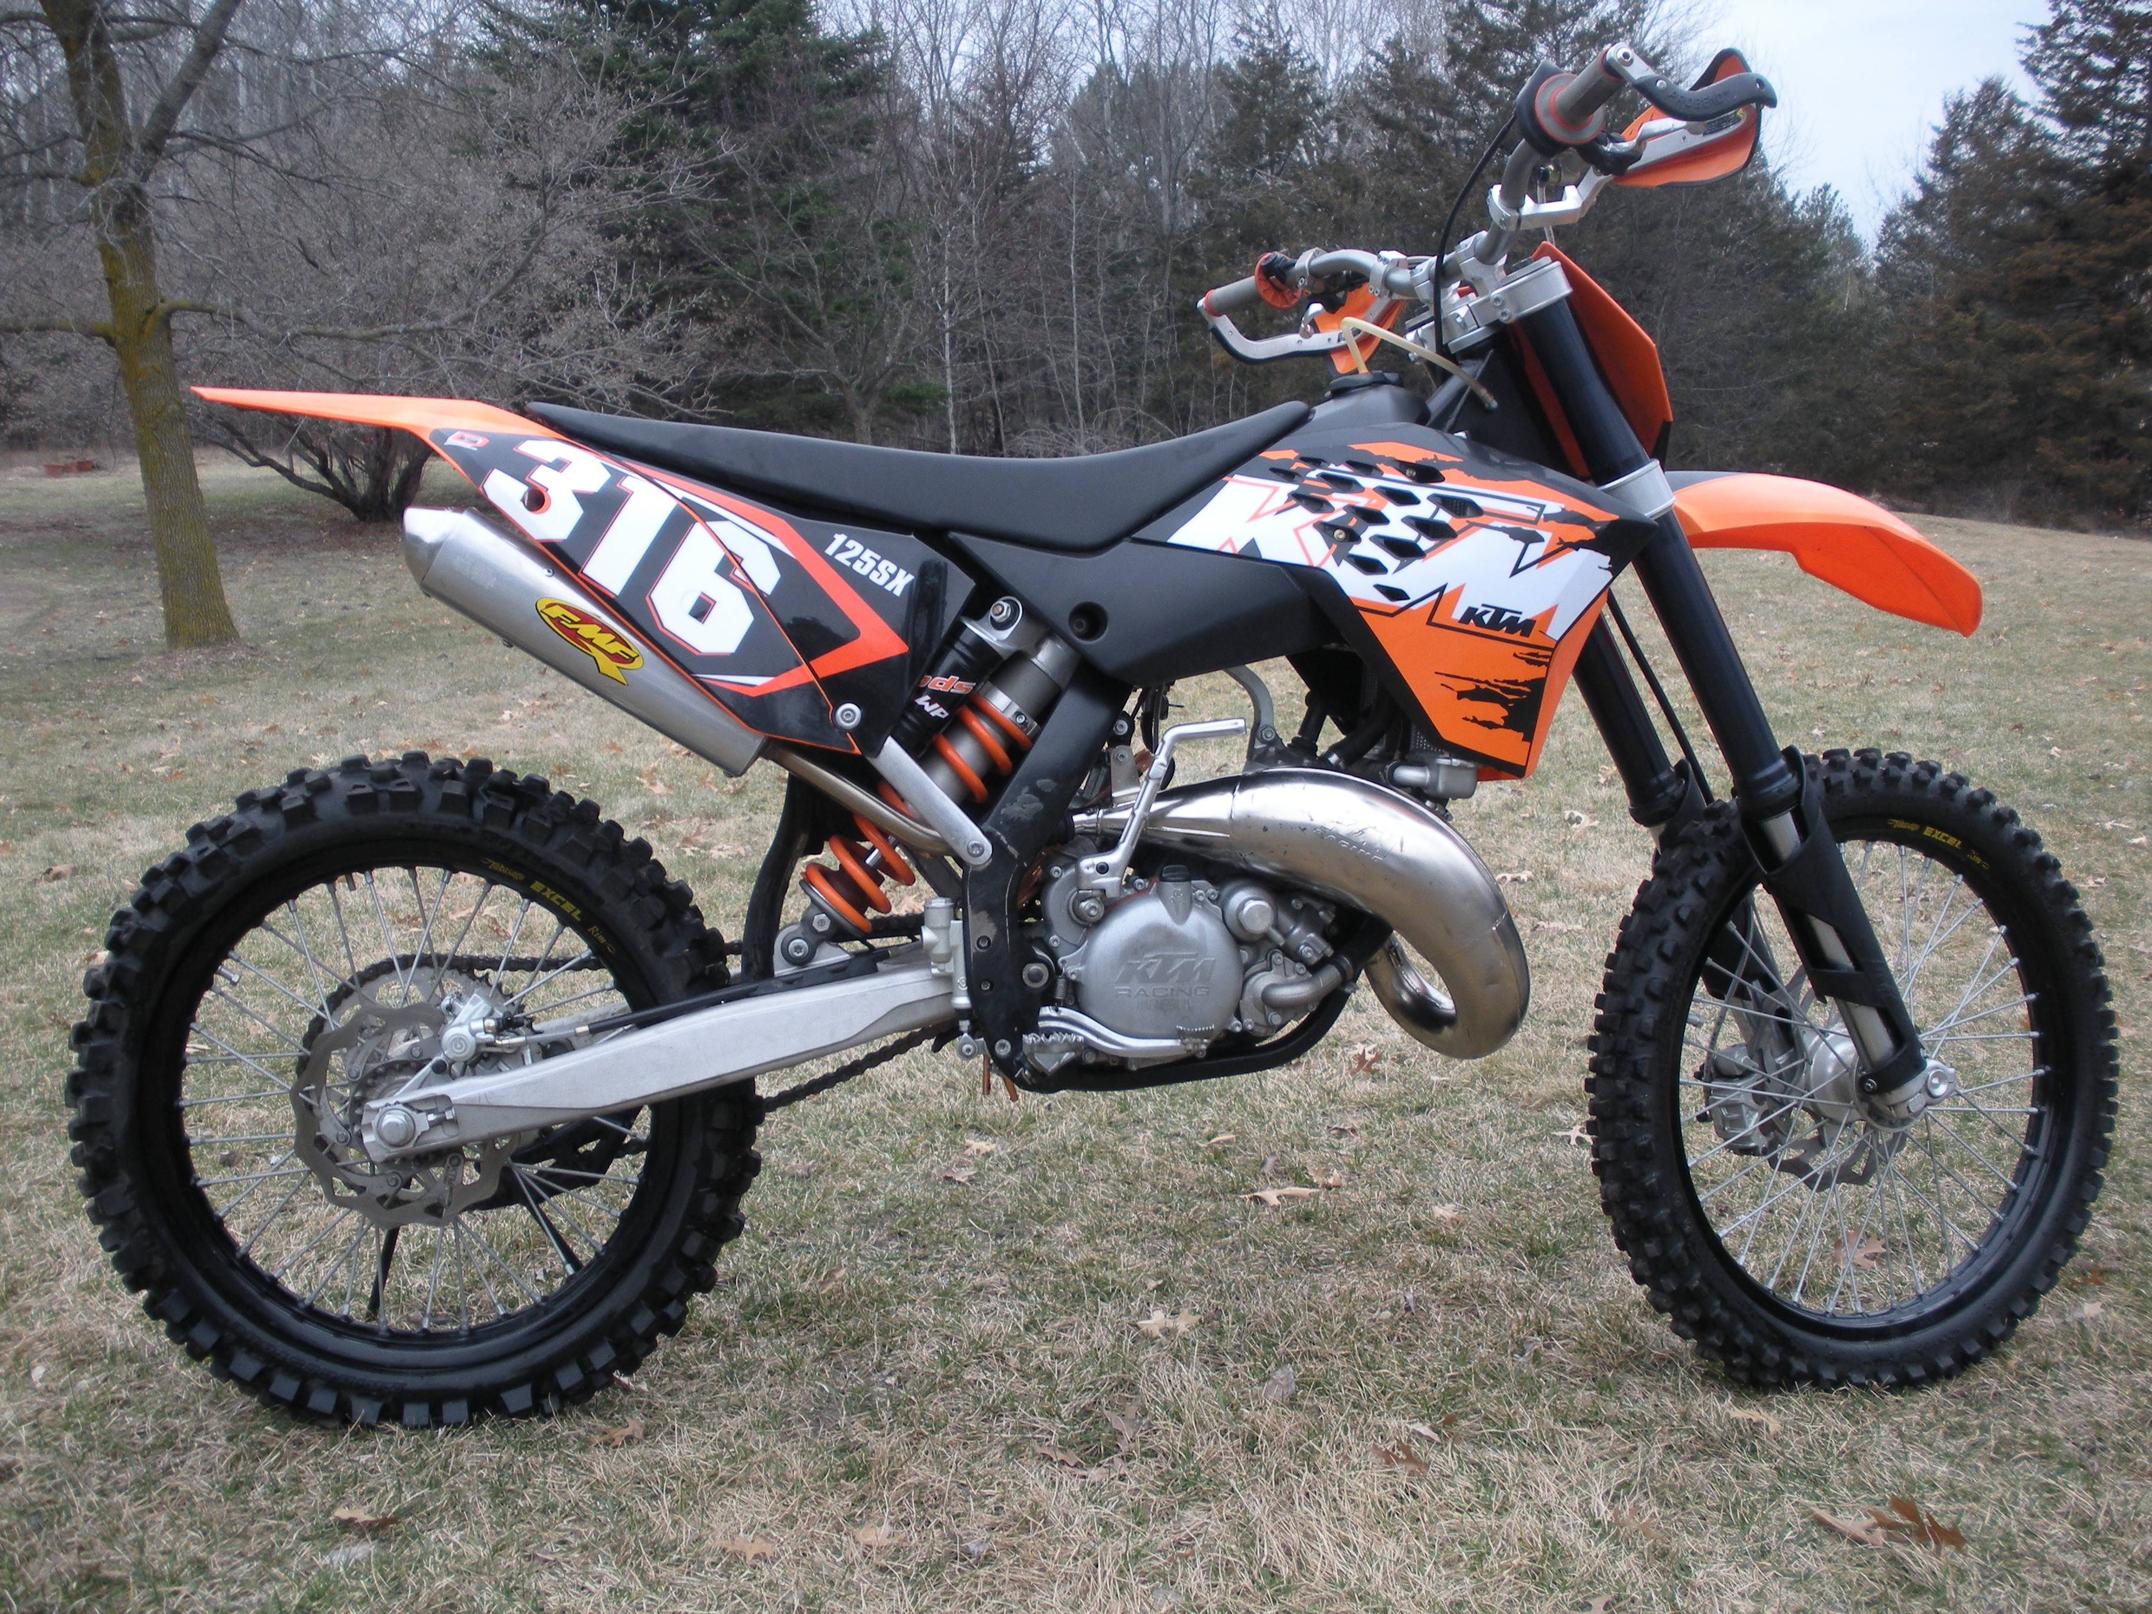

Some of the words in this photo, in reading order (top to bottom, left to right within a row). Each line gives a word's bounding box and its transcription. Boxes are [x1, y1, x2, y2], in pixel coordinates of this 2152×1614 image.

[480, 440, 782, 656] 316
[824, 533, 915, 597] 125SX
[540, 604, 638, 664] FMF
[1457, 603, 1537, 638] KTM
[914, 695, 949, 719] WP
[1922, 826, 1962, 848] EXCEL
[529, 881, 581, 921] EXCEL
[1115, 951, 1216, 984] KTM
[1114, 985, 1209, 998] RACING
